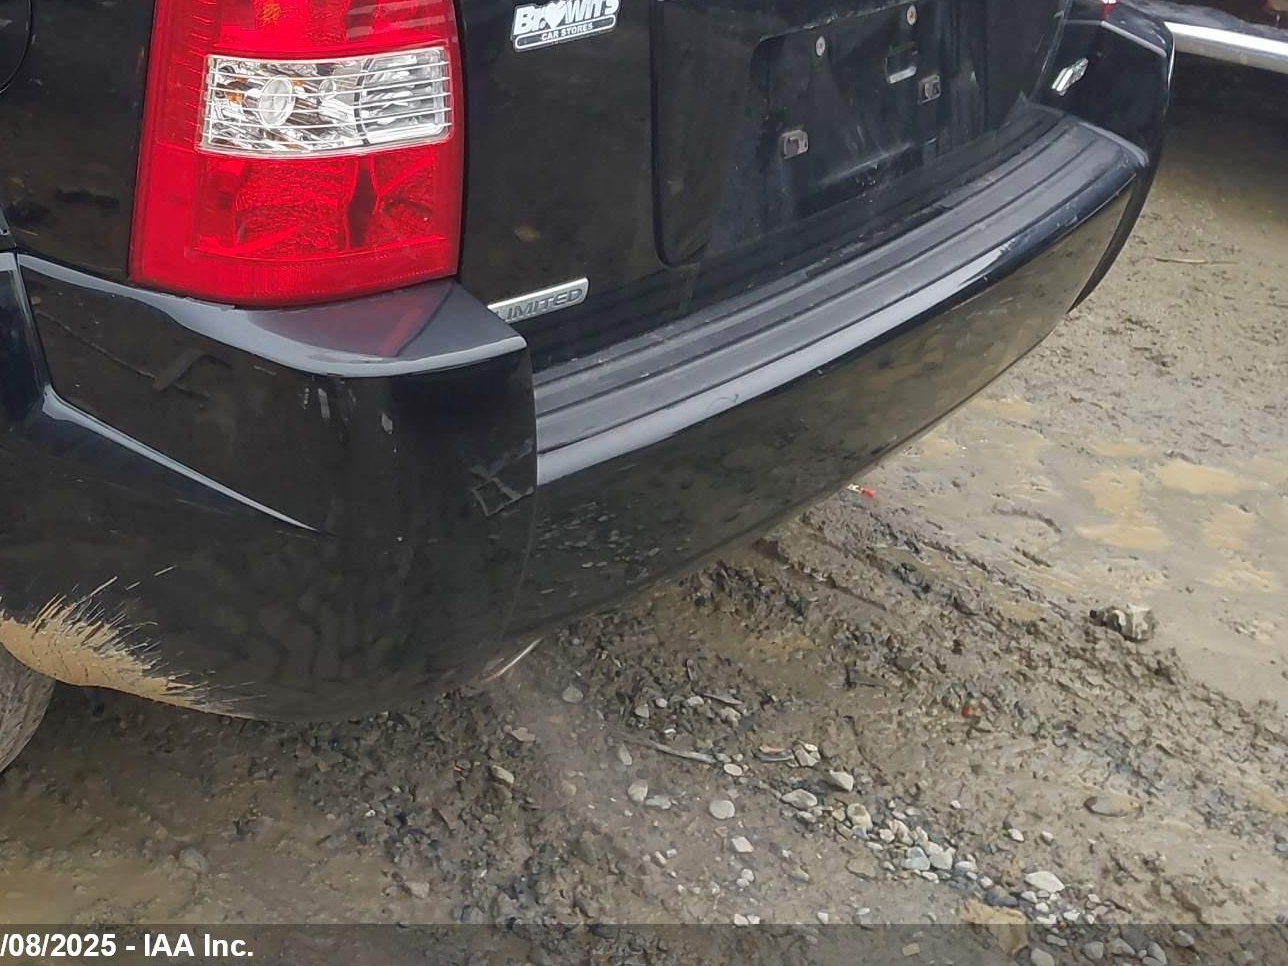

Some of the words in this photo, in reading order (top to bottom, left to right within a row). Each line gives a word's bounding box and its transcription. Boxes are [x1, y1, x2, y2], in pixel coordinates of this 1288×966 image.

[541, 31, 559, 41] CAR
[561, 22, 594, 37] STORES
[505, 288, 583, 320] IMITED
